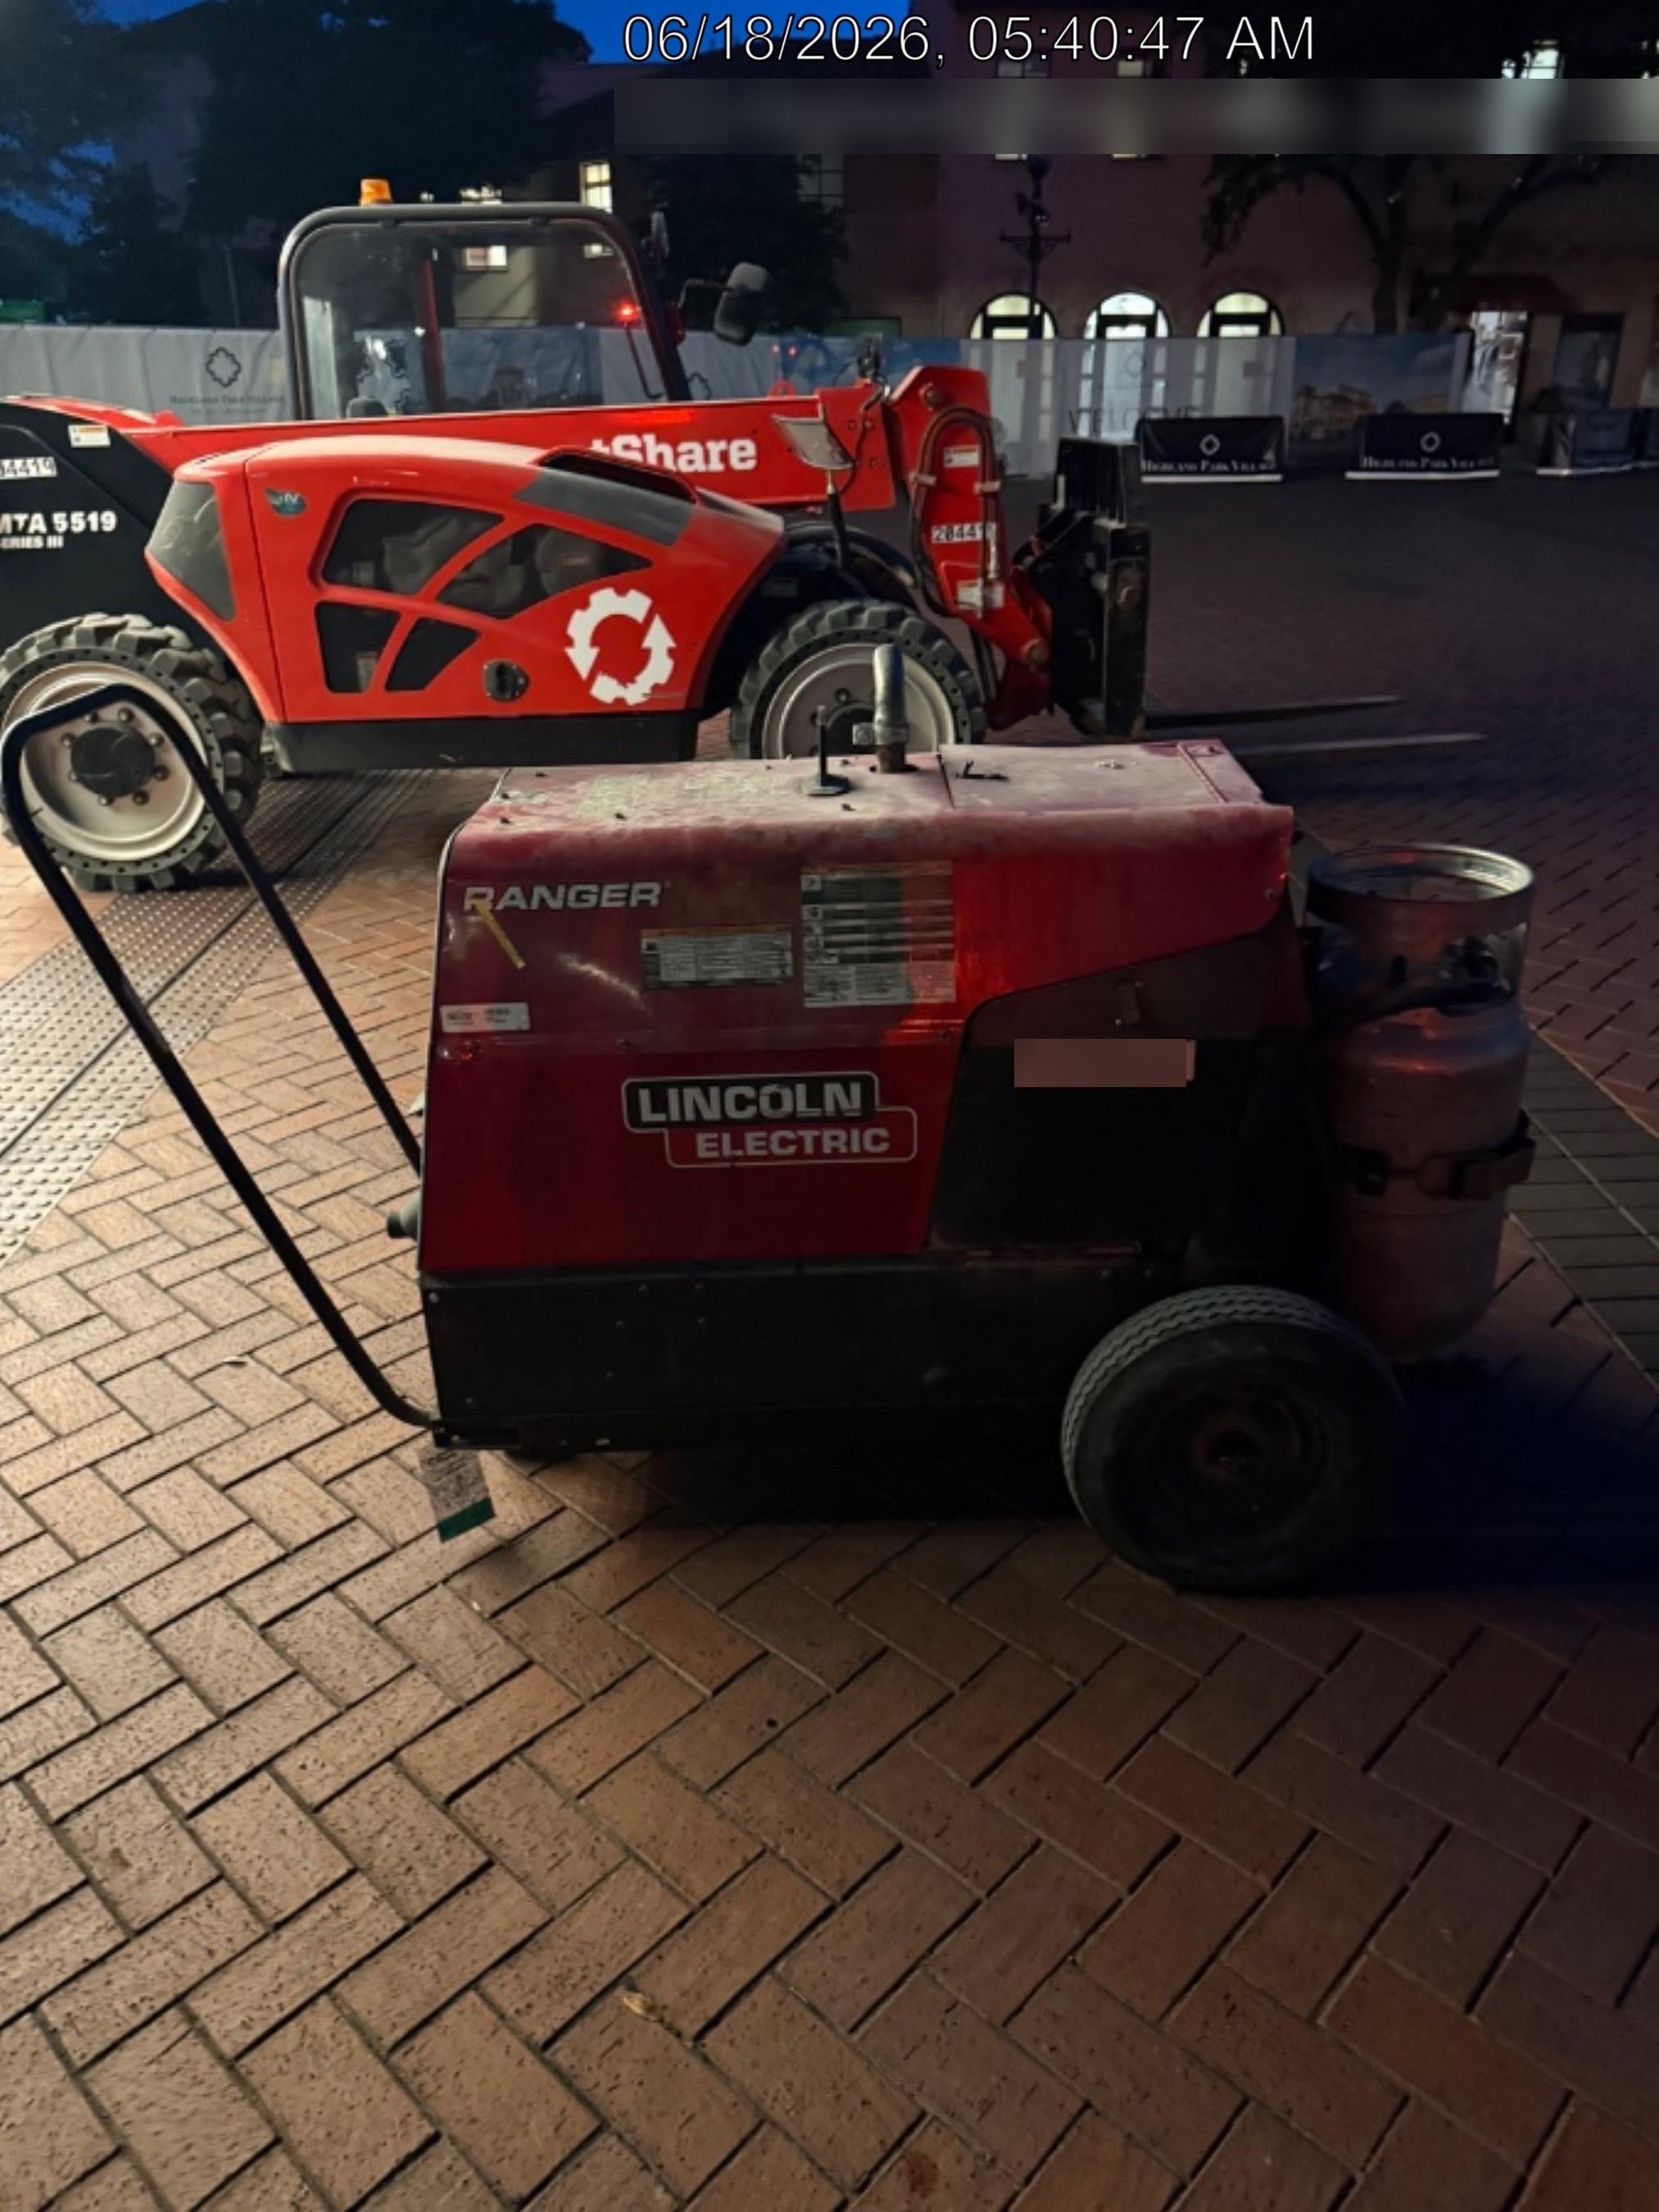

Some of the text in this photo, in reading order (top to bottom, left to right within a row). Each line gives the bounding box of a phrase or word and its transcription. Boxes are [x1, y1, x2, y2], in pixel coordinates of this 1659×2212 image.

[52, 510, 117, 534] 5519
[934, 524, 995, 542] 2844
[0, 534, 65, 549] ERIES III
[463, 881, 663, 911] RANGER
[638, 1081, 861, 1122] LINCOLN
[695, 1127, 891, 1159] ELECTRIC
